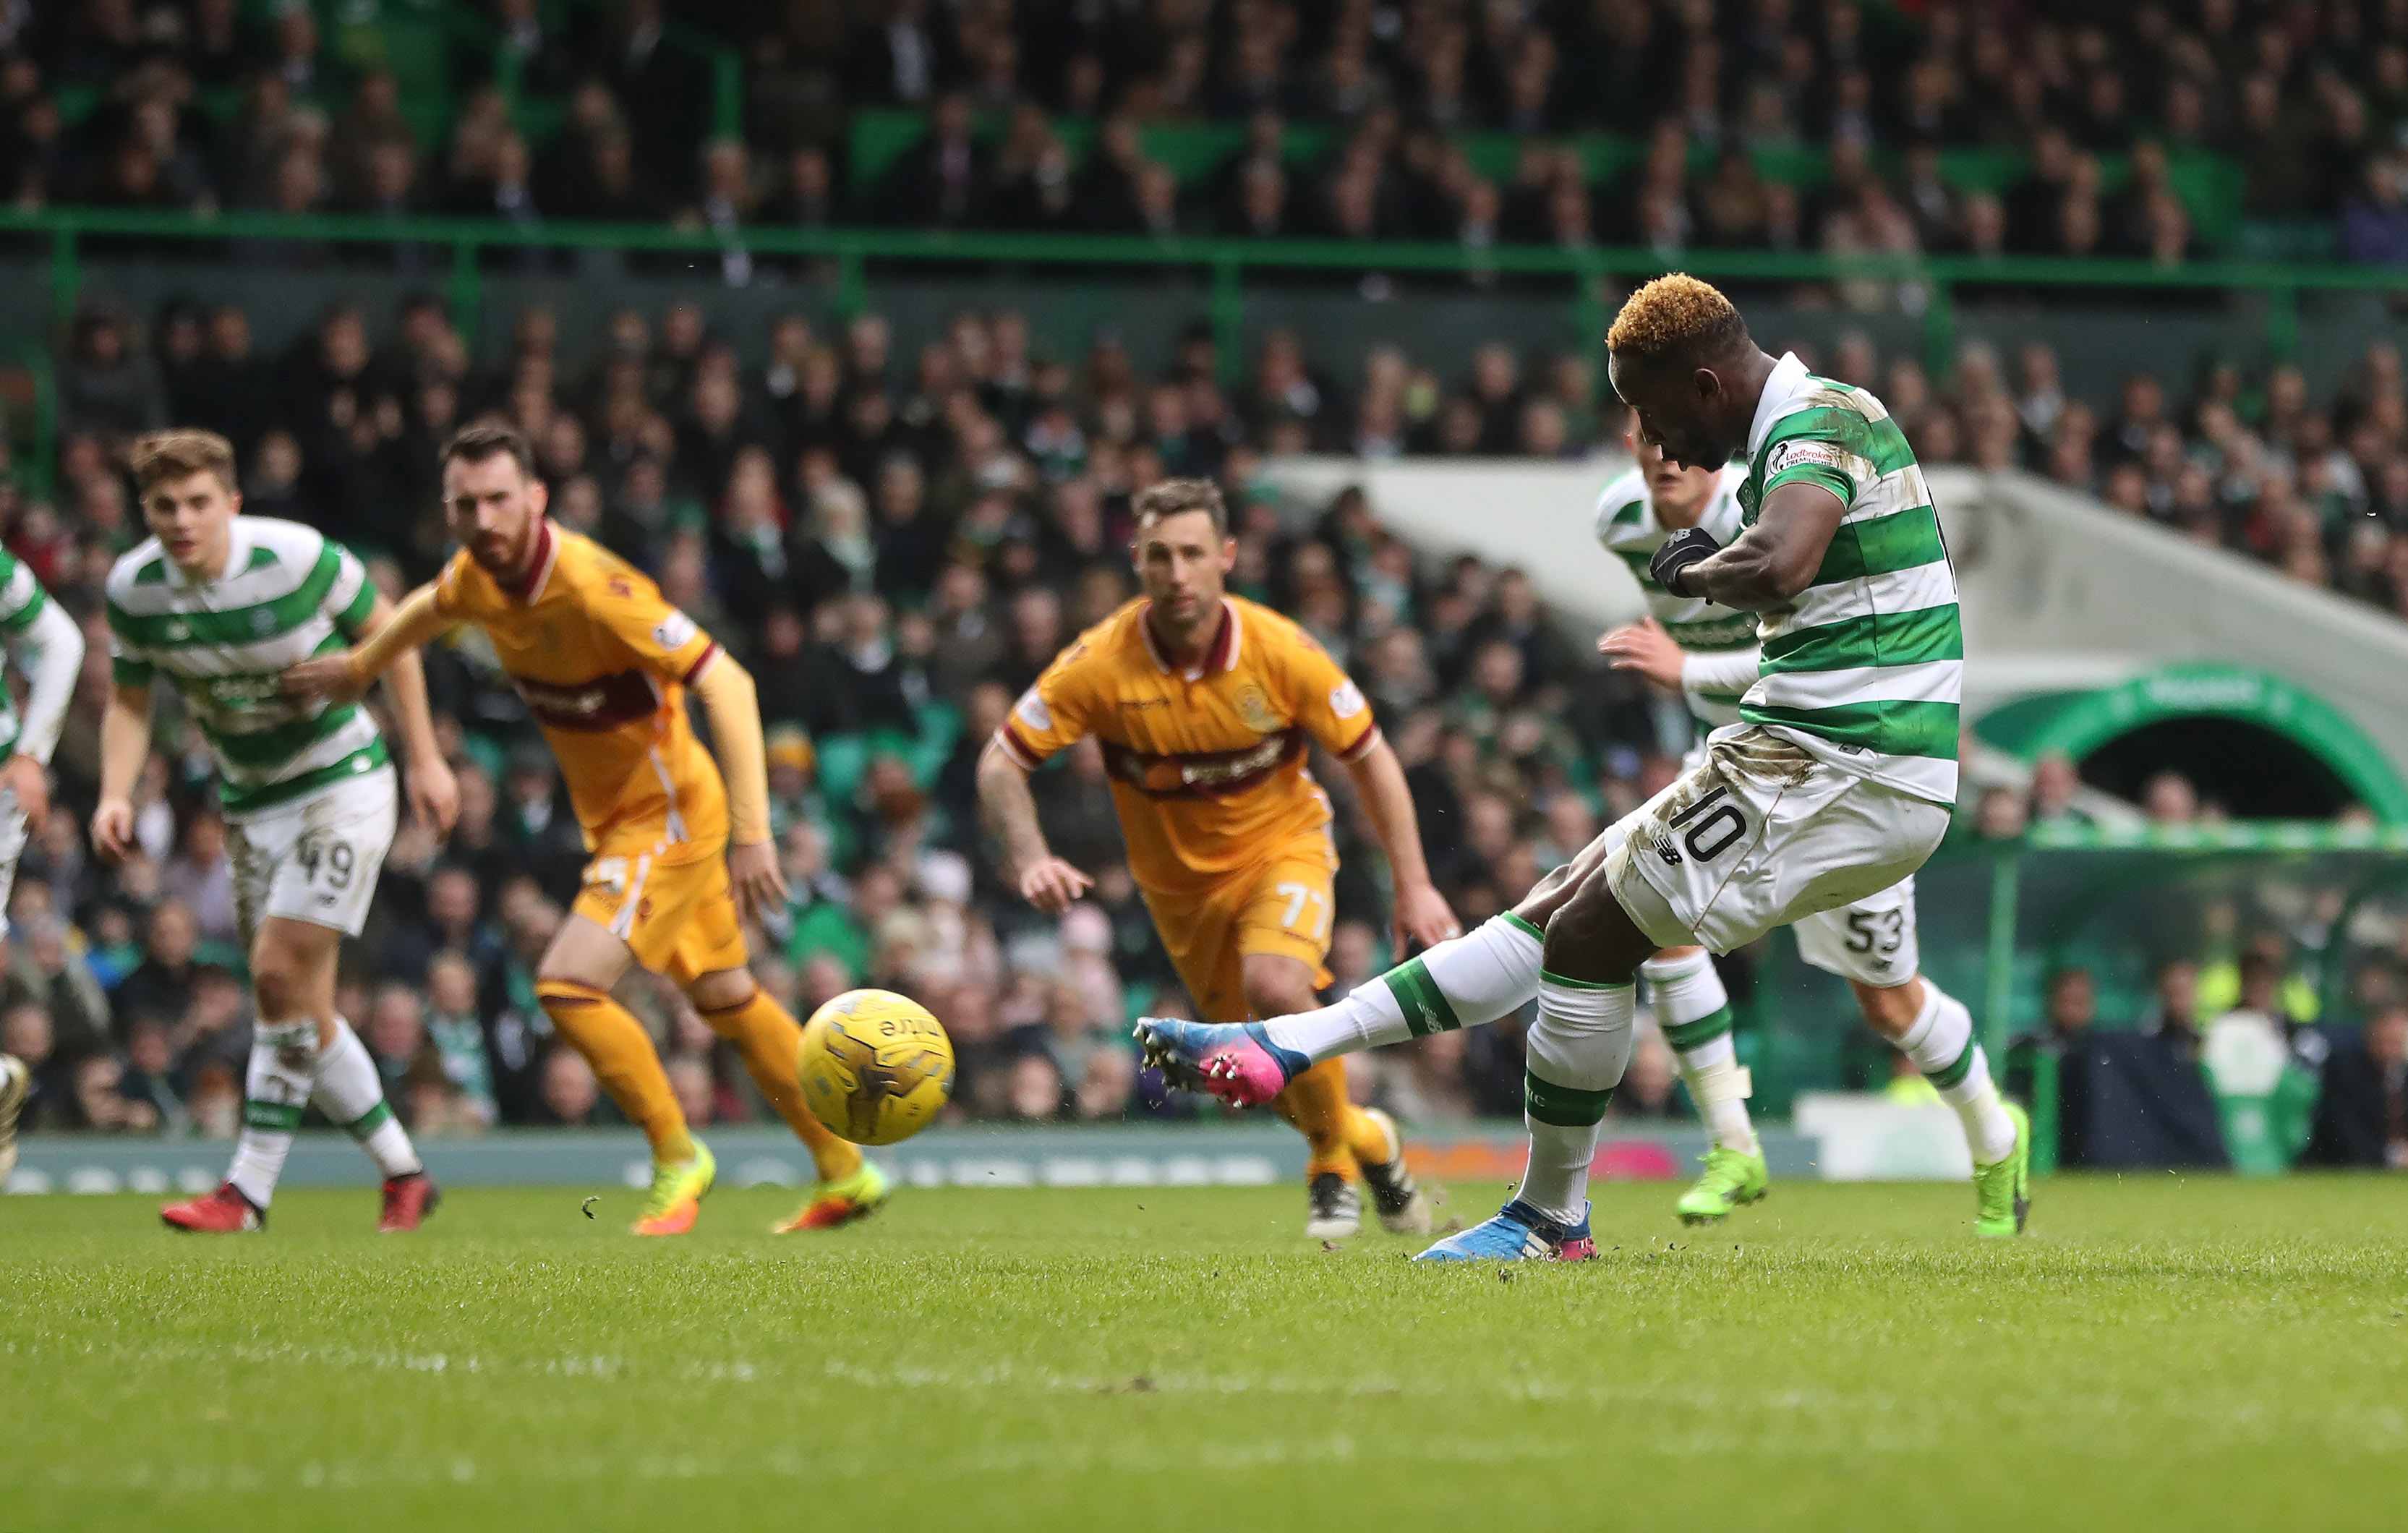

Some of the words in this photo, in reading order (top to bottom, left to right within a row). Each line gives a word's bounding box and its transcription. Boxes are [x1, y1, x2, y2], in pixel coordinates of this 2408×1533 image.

[1785, 448, 1833, 462] Ladbrokes
[1668, 785, 1747, 863] 10
[295, 830, 353, 889] 49
[1276, 883, 1328, 939] 77
[1845, 908, 1904, 955] 53
